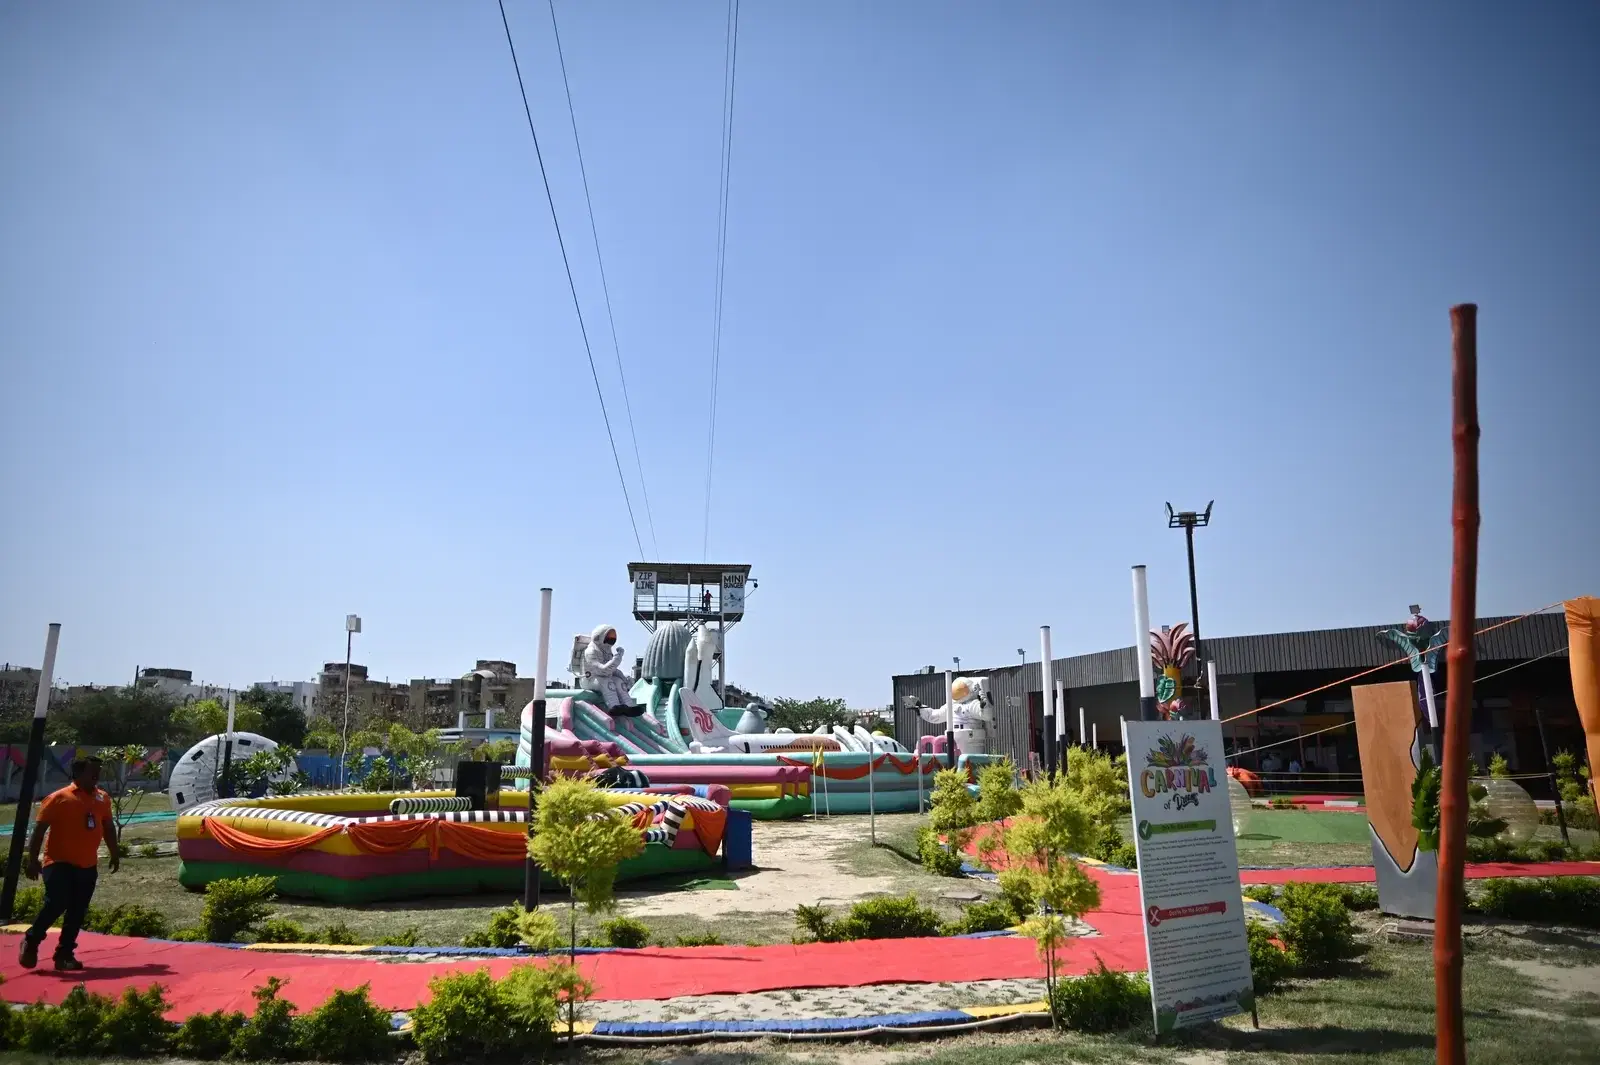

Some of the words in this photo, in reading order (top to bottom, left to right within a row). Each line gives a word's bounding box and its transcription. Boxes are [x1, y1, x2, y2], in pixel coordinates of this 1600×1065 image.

[639, 571, 652, 580] ZIP
[723, 575, 743, 583] MINI
[635, 581, 654, 590] LINE
[1140, 767, 1217, 798] CARNIVAL
[1164, 799, 1171, 810] of
